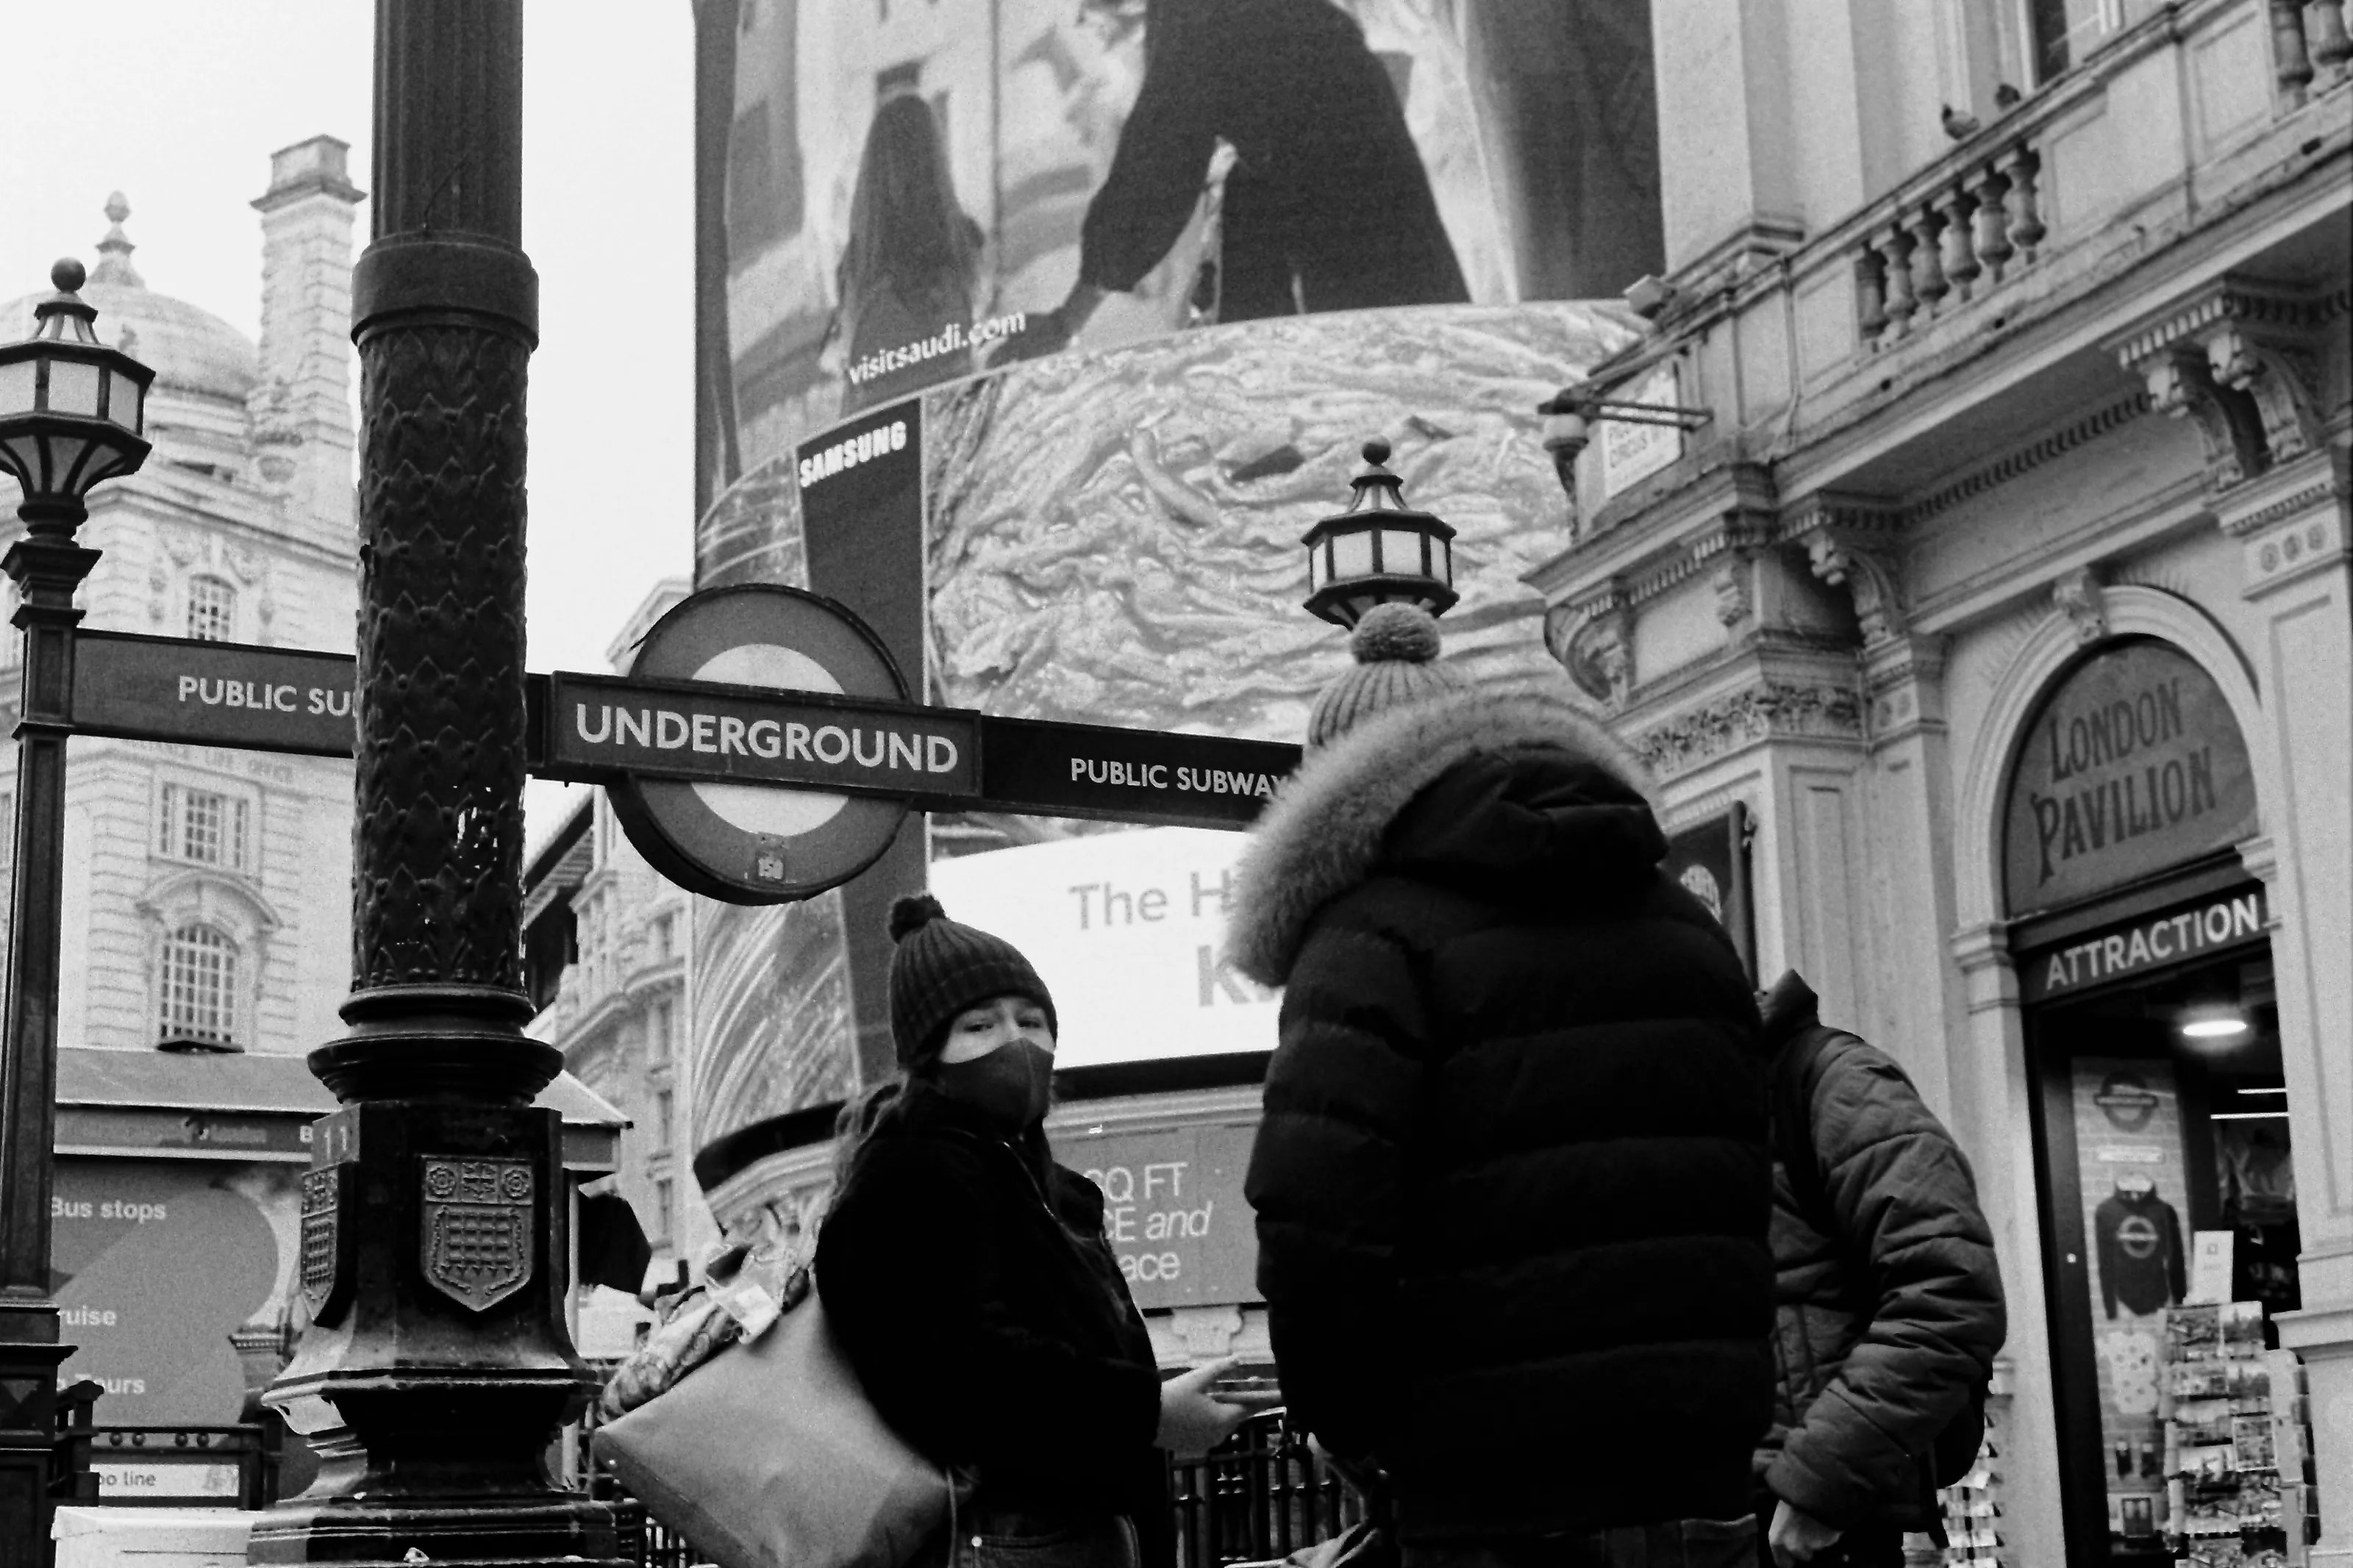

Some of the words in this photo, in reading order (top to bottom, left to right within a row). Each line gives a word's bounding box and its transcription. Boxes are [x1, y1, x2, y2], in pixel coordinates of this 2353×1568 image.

[847, 312, 1026, 384] visitsaudi.com
[799, 421, 907, 488] SAMSUNG
[179, 675, 297, 712] PUBLIC
[308, 687, 357, 717] SU
[576, 703, 958, 773] UNDERGROUND
[2049, 677, 2183, 783] LONDON
[1071, 758, 1168, 789] PUBLIC
[2031, 747, 2218, 888] PAVILION
[1068, 881, 1169, 931] The
[2045, 894, 2260, 990] ATTRACTION
[1144, 1161, 1188, 1200] FT
[100, 1199, 168, 1224] stops
[1145, 1200, 1213, 1241] and
[123, 1471, 157, 1486] line
